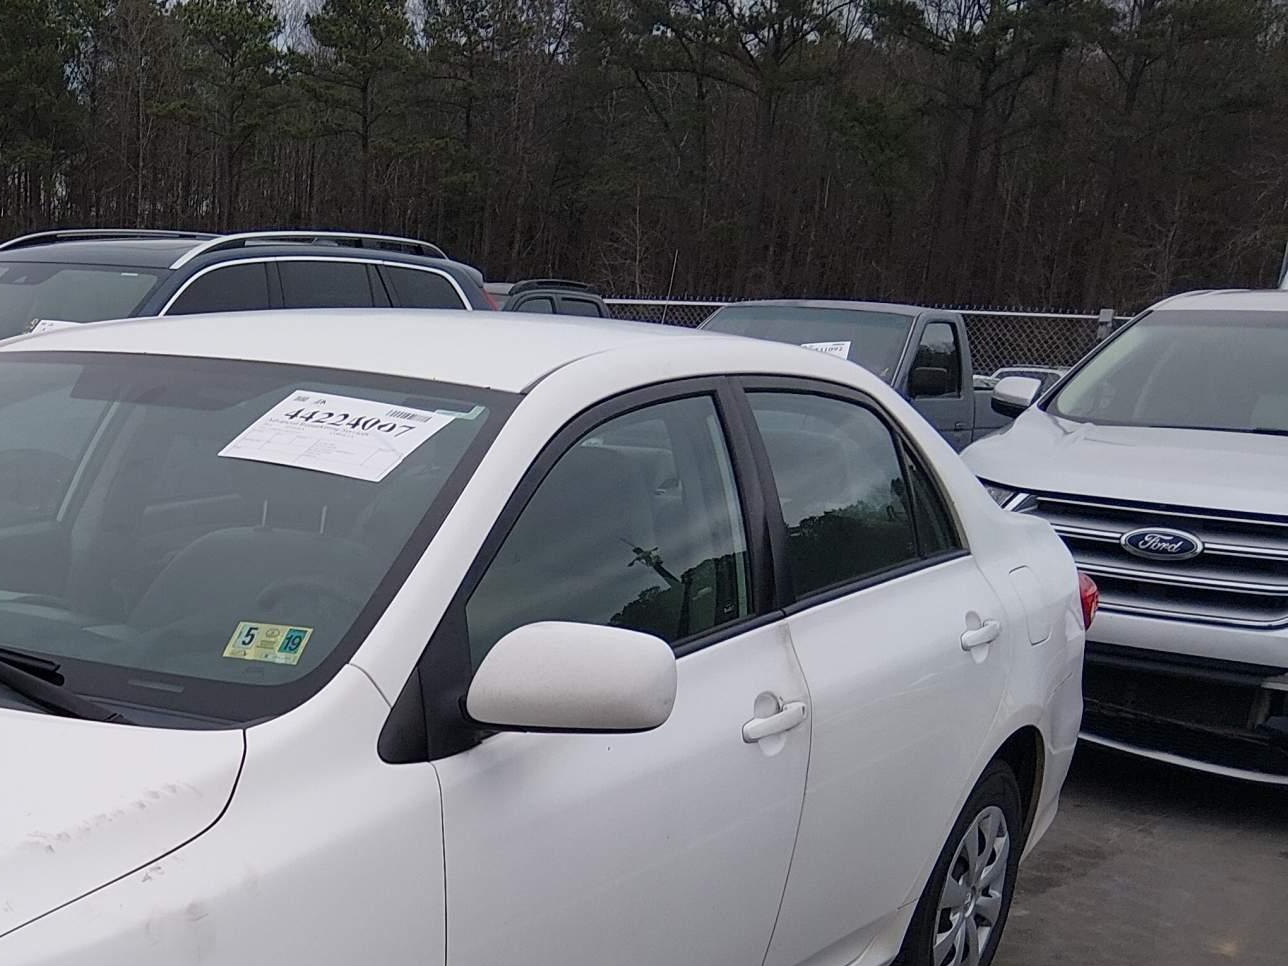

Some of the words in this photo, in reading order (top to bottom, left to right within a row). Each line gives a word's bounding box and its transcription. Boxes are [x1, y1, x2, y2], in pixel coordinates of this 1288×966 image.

[284, 408, 416, 437] 44224007
[1138, 533, 1184, 553] Ford
[241, 626, 259, 647] 5
[283, 633, 303, 652] 19
